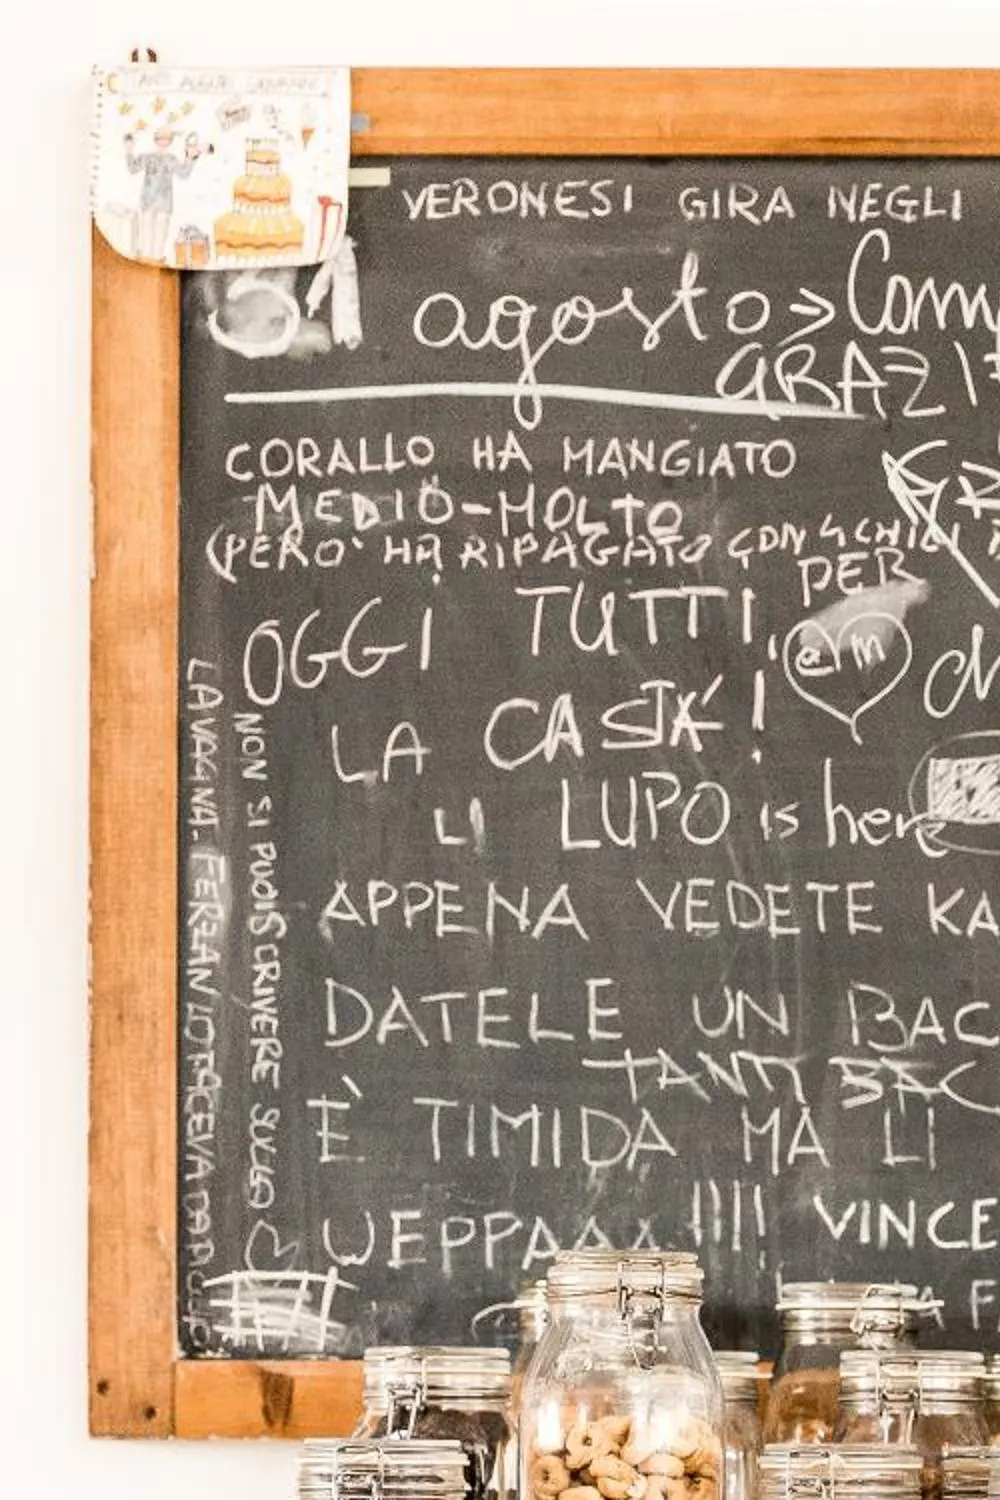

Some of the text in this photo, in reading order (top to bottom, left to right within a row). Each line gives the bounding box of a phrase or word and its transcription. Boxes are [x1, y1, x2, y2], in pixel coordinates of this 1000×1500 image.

[402, 179, 634, 221] VERONESI
[678, 182, 797, 224] GIRA
[827, 183, 963, 222] NEGLI
[412, 250, 772, 430] agosto
[225, 431, 797, 479] CORALLO HA MANGIATO
[461, 533, 712, 569] RIPAGATO
[798, 547, 926, 608] PER
[242, 597, 434, 706] OGGI
[234, 712, 269, 781] NON
[329, 719, 432, 783] LA
[433, 797, 486, 850] LI
[560, 774, 731, 850] LUPO
[318, 877, 591, 940] APPENA
[636, 877, 883, 937] VEDETE
[323, 975, 624, 1049] DATELE
[691, 984, 790, 1041] UN
[413, 1096, 678, 1172] TIMIDA
[741, 1106, 831, 1176] MA
[881, 1106, 939, 1171] LI
[812, 1194, 999, 1250] VINCE
